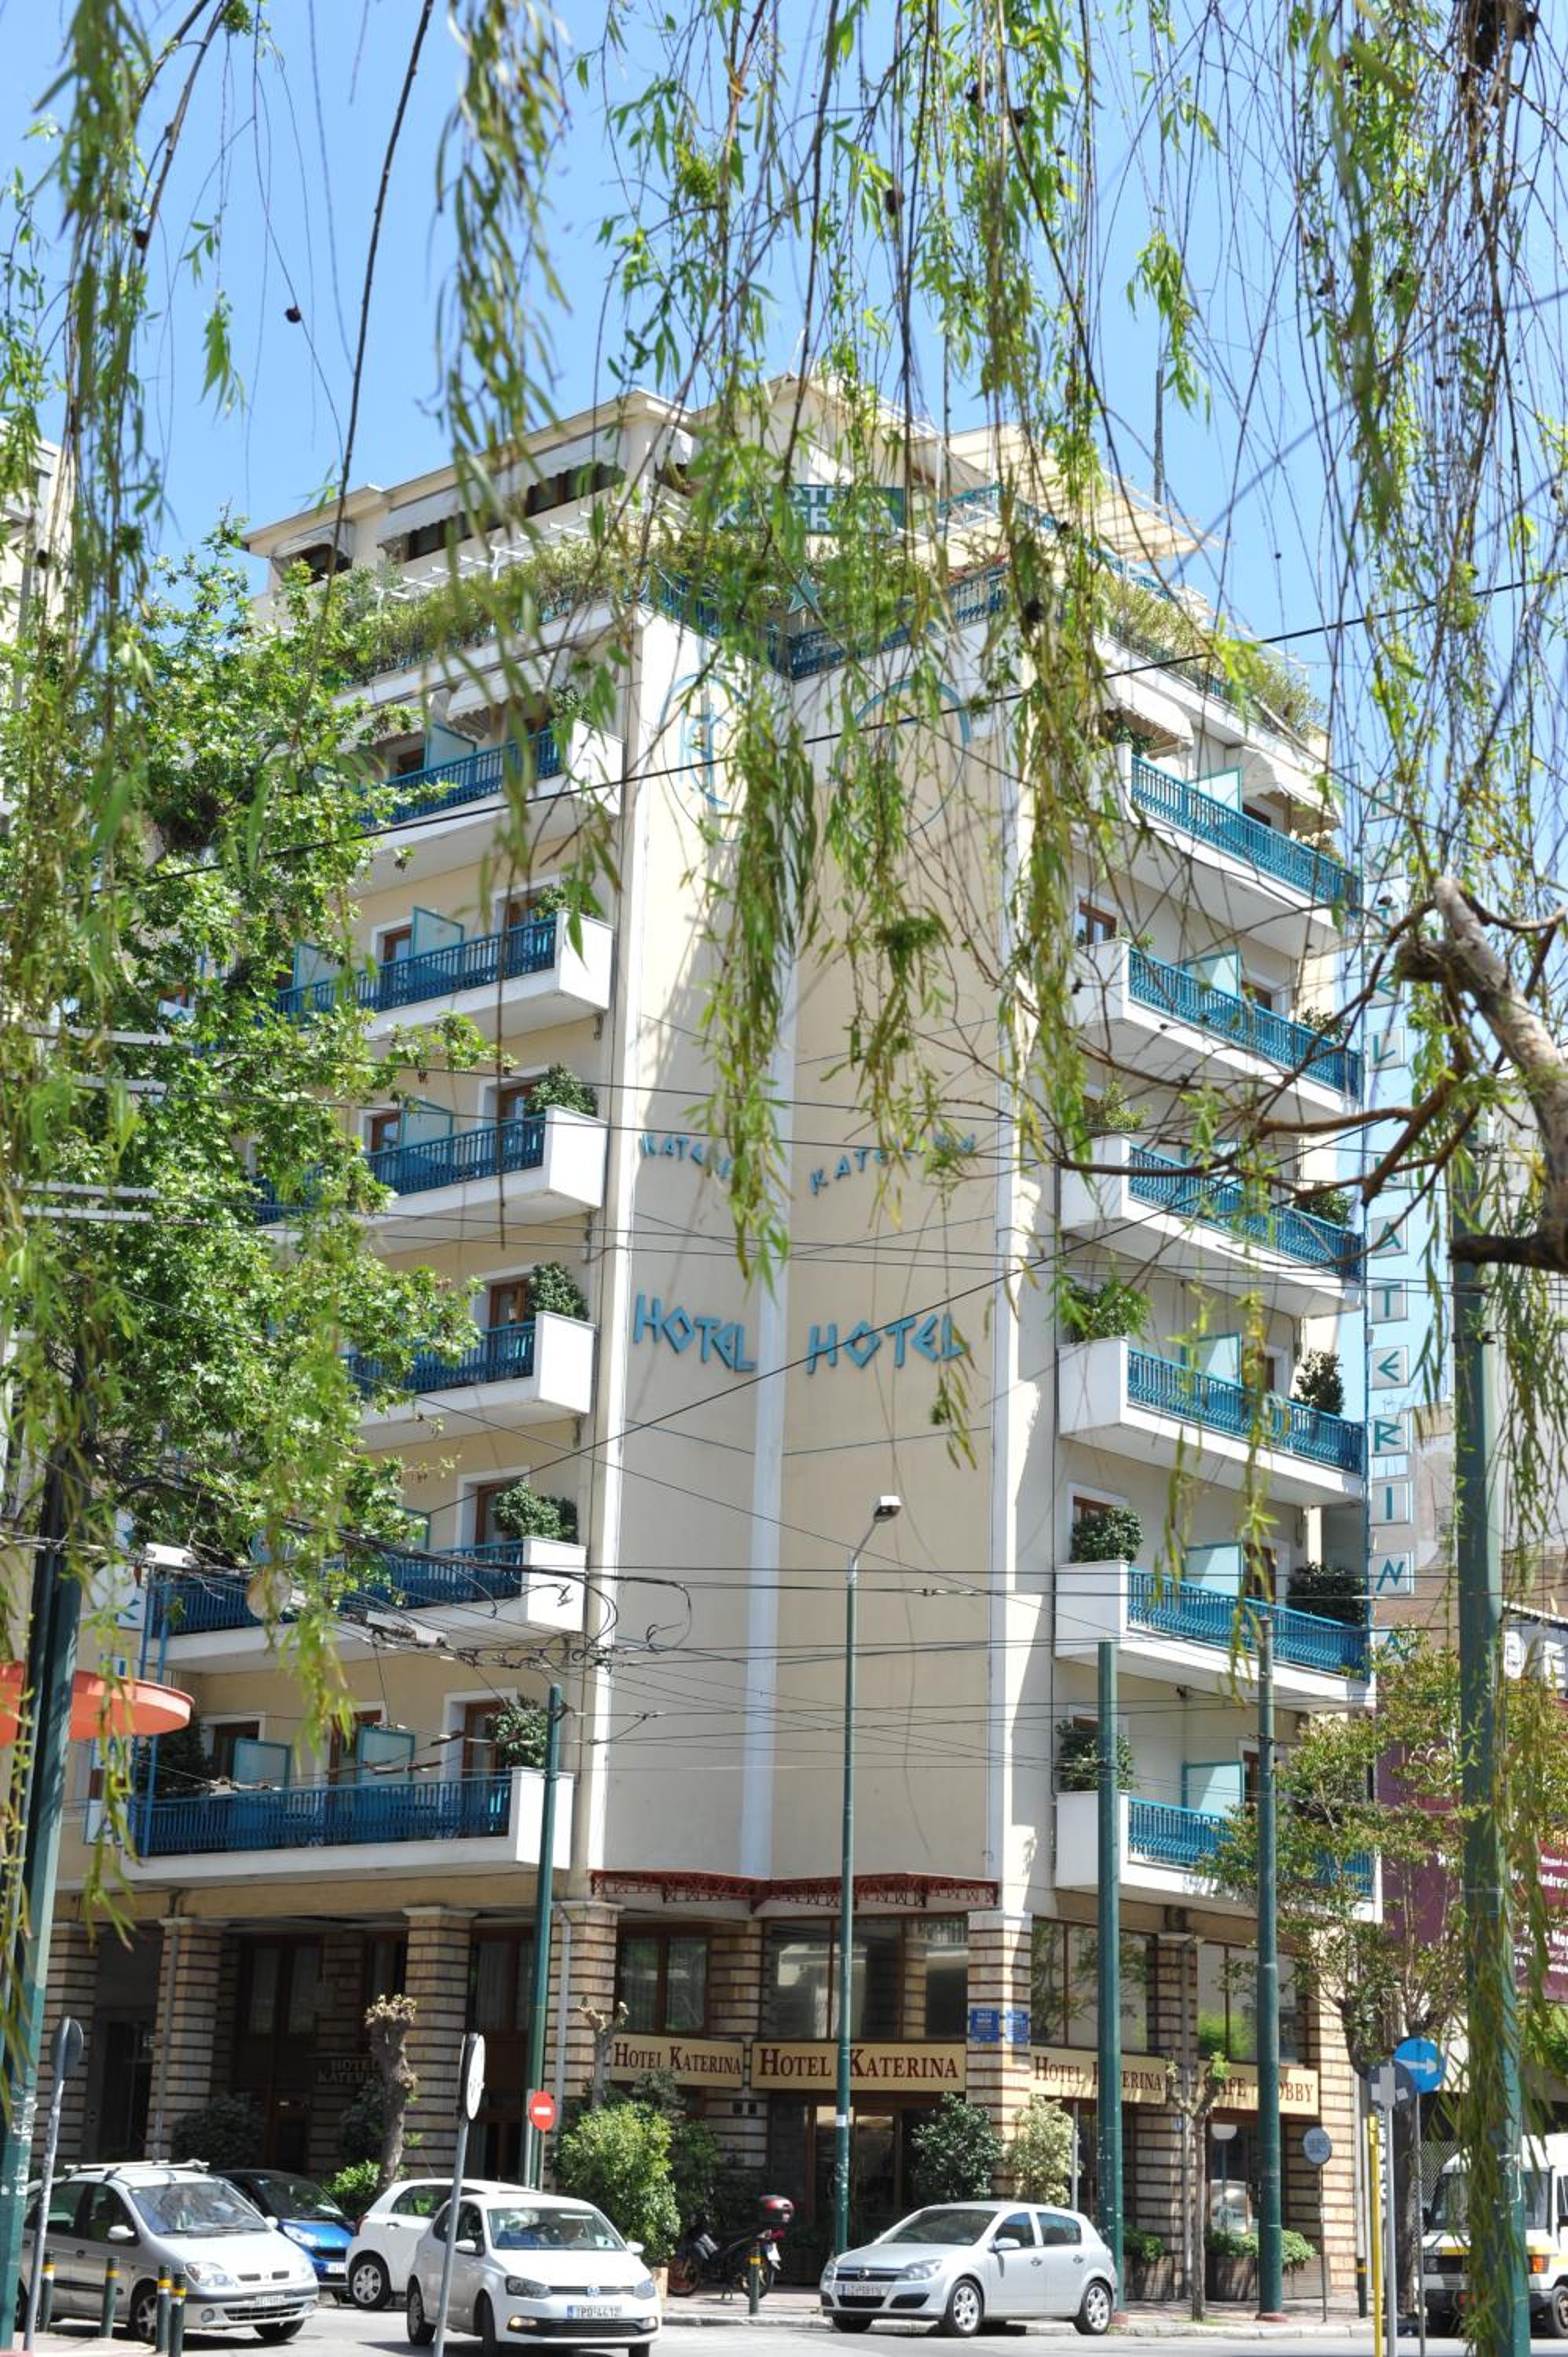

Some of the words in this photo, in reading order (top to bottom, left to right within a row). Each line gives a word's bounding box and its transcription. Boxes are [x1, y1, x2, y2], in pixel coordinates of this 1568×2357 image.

[633, 1293, 754, 1373] HOTEL
[806, 1313, 971, 1375] HOTEL
[669, 2046, 742, 2075] KATERINA
[758, 2048, 832, 2077] HOTEL
[848, 2048, 958, 2078] KATERINA
[1034, 2056, 1083, 2084] HOTEL
